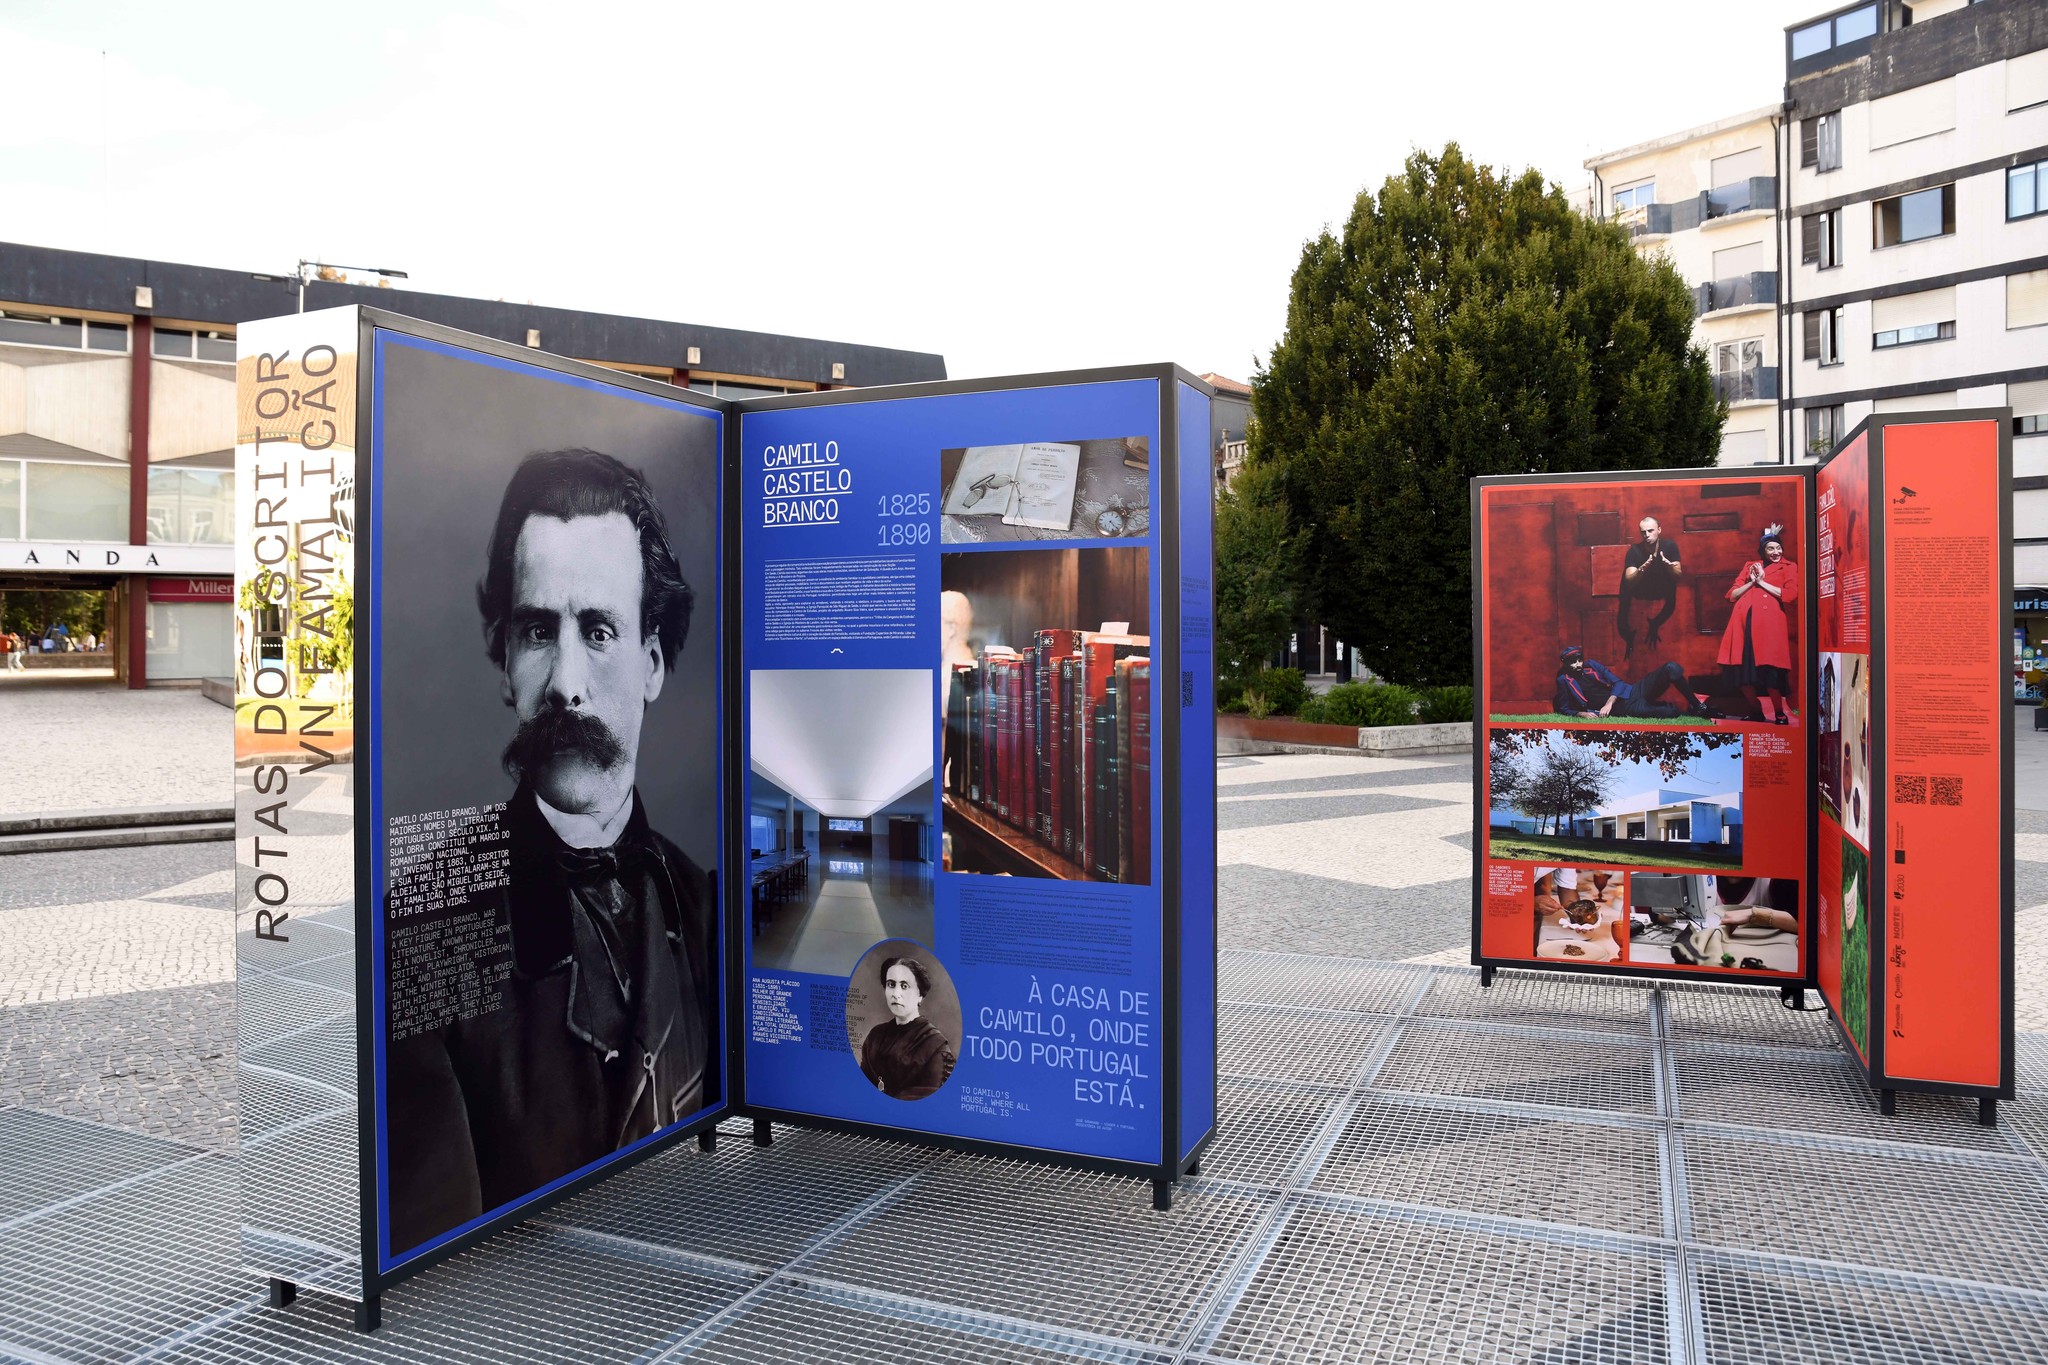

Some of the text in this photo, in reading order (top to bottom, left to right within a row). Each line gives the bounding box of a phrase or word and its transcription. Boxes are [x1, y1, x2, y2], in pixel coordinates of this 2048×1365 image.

[764, 440, 838, 467] CAMILO
[764, 468, 851, 496] CASTELO
[764, 498, 838, 524] BRANCO
[878, 493, 931, 518] 1825
[878, 522, 931, 546] 1890
[292, 344, 336, 776] VN FAMALICÃO
[254, 350, 289, 943] ROTAS DO ESCRITOR
[390, 803, 507, 826] CAMILO CASTELO BRANCO, UM DOS
[390, 813, 499, 836] MAIORES NOMES DA LITERATURA
[390, 832, 434, 846] PORTUGUESA
[437, 831, 445, 839] DO
[449, 827, 473, 838] SÉCULO
[476, 824, 491, 833] XIX.
[390, 831, 510, 857] SUA OBRA CONSTITUI UM MARCO DO
[390, 846, 472, 867] ROMANTISMO NACIONAL.
[390, 868, 399, 877] NO
[403, 862, 433, 875] INVERNO
[436, 861, 444, 869] DE
[448, 858, 466, 867] 1863,
[478, 850, 509, 862] ESCRITOR
[391, 859, 510, 887] E SUA FAMÍLIA INSTALARAM-SE NA
[391, 870, 507, 898] ALDEIA DE SÃO MIGUEL DE SEIDE,
[391, 876, 510, 908] EM FAMALICÃO, ONDE VIVERAM ATÉ
[391, 895, 470, 918] O FIM DE SUAS VIDAS.
[392, 909, 496, 938] CAMILO CASTELO BRANCO, WAS
[392, 918, 494, 949] A KEY FIGURE IN PORTUGUESE
[392, 924, 511, 959] LITERATURE, KNOWN FOR HIS WORK
[392, 938, 496, 970] AS A NOVELIST, CHRONICLER,
[392, 943, 512, 980] CRITIC, PLAYWRIGHT, HISTORIAN,
[393, 961, 477, 990] POET, AND TRANSLATOR.
[393, 960, 513, 1001] IN THE WINTER OF 1863, HE MOVED
[393, 970, 510, 1011] WITH HIS FAMILY TO THE VILLAGE
[781, 980, 800, 988] PLÁCIDO
[393, 984, 492, 1021] OF SÃO MIGUEL DE SEIDE IN
[1028, 974, 1149, 1016] À CASA DE
[393, 991, 502, 1032] FAMALICÃO, WHERE THEY LIVED
[393, 1000, 503, 1042] FOR THE REST OF THEIR LIVES.
[980, 1006, 1149, 1047] CAMILO, ONDE
[967, 1036, 1148, 1078] TODO PORTUGAL
[961, 1095, 988, 1106] HOUSE,
[991, 1099, 1014, 1108] WHERE
[973, 1088, 1010, 1098] CAMILO'S
[1074, 1078, 1146, 1109] ESTÁ.
[961, 1104, 1013, 1118] PORTUGAL IS.
